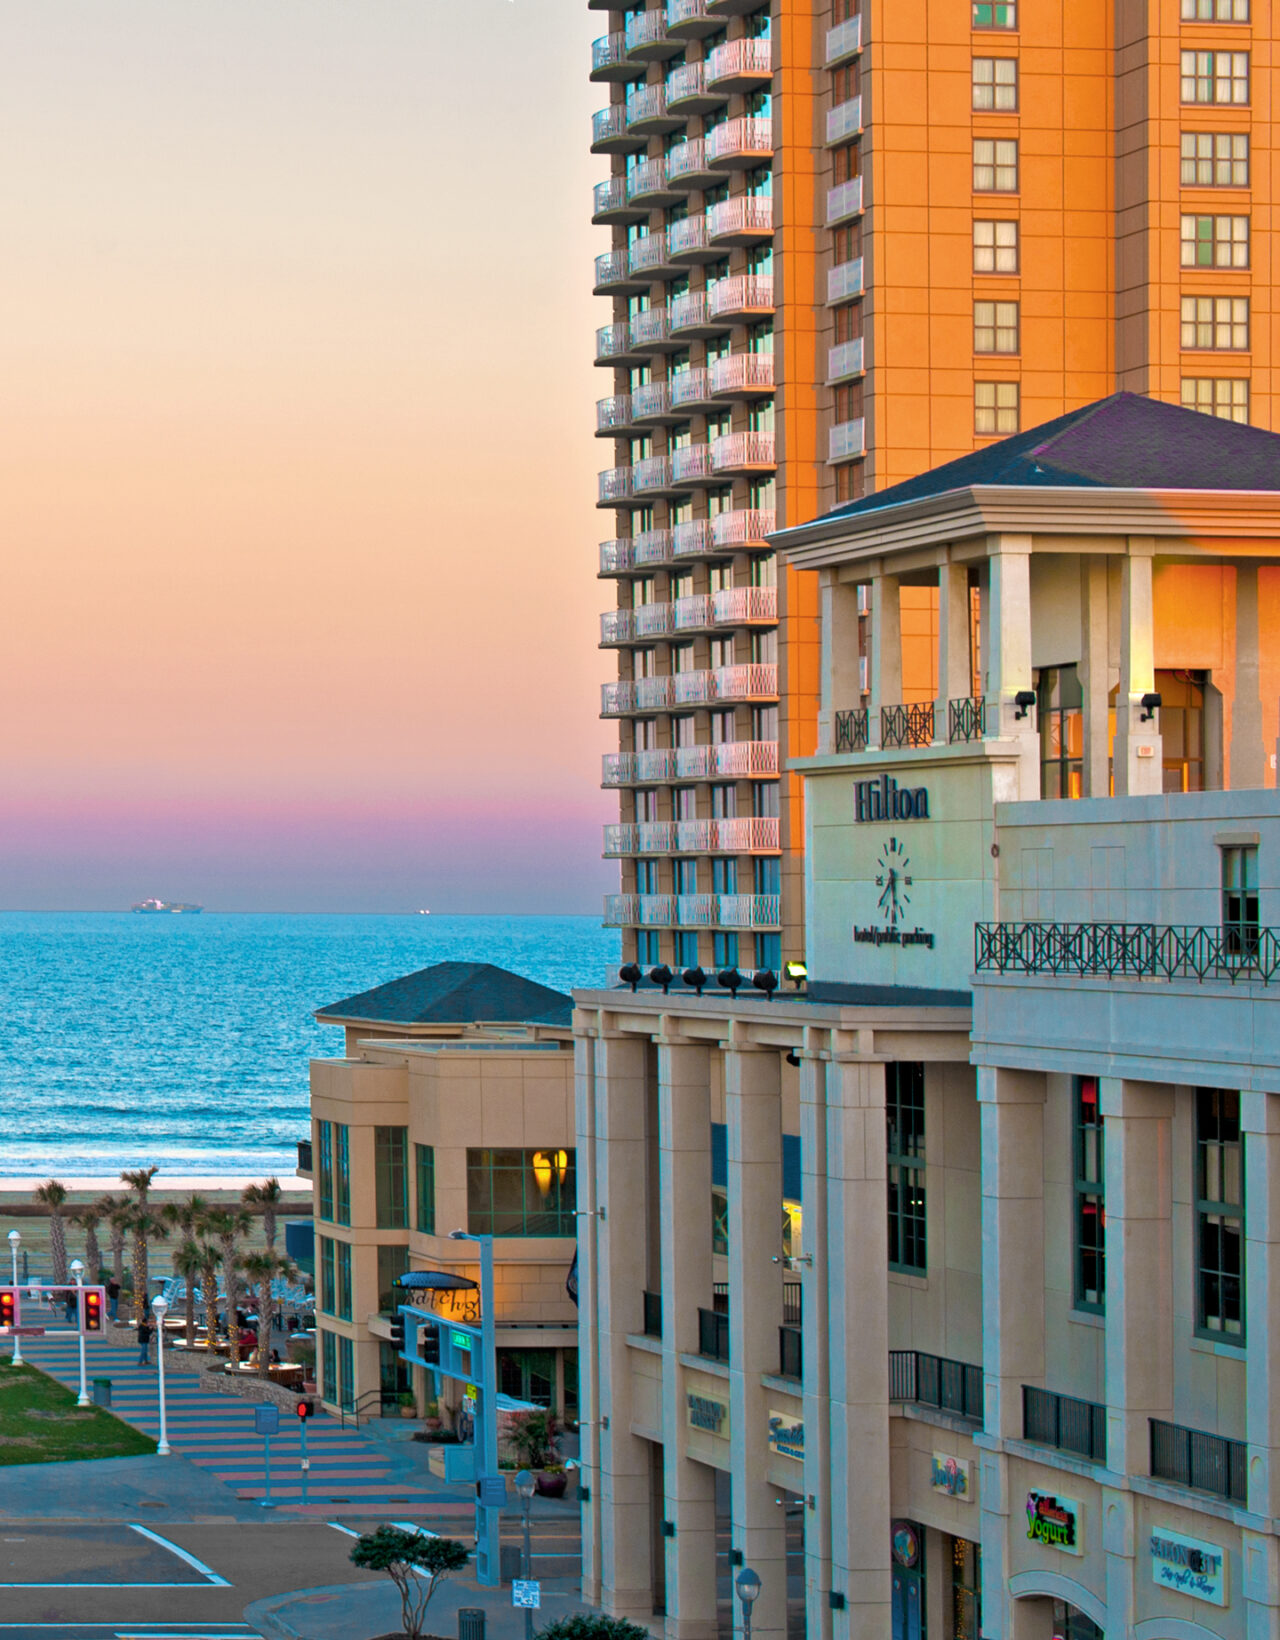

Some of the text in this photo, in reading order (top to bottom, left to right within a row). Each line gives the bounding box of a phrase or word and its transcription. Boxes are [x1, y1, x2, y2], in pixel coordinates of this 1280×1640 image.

[853, 774, 930, 822] Hilton
[902, 927, 934, 948] parking
[1151, 1536, 1187, 1565] SALON
